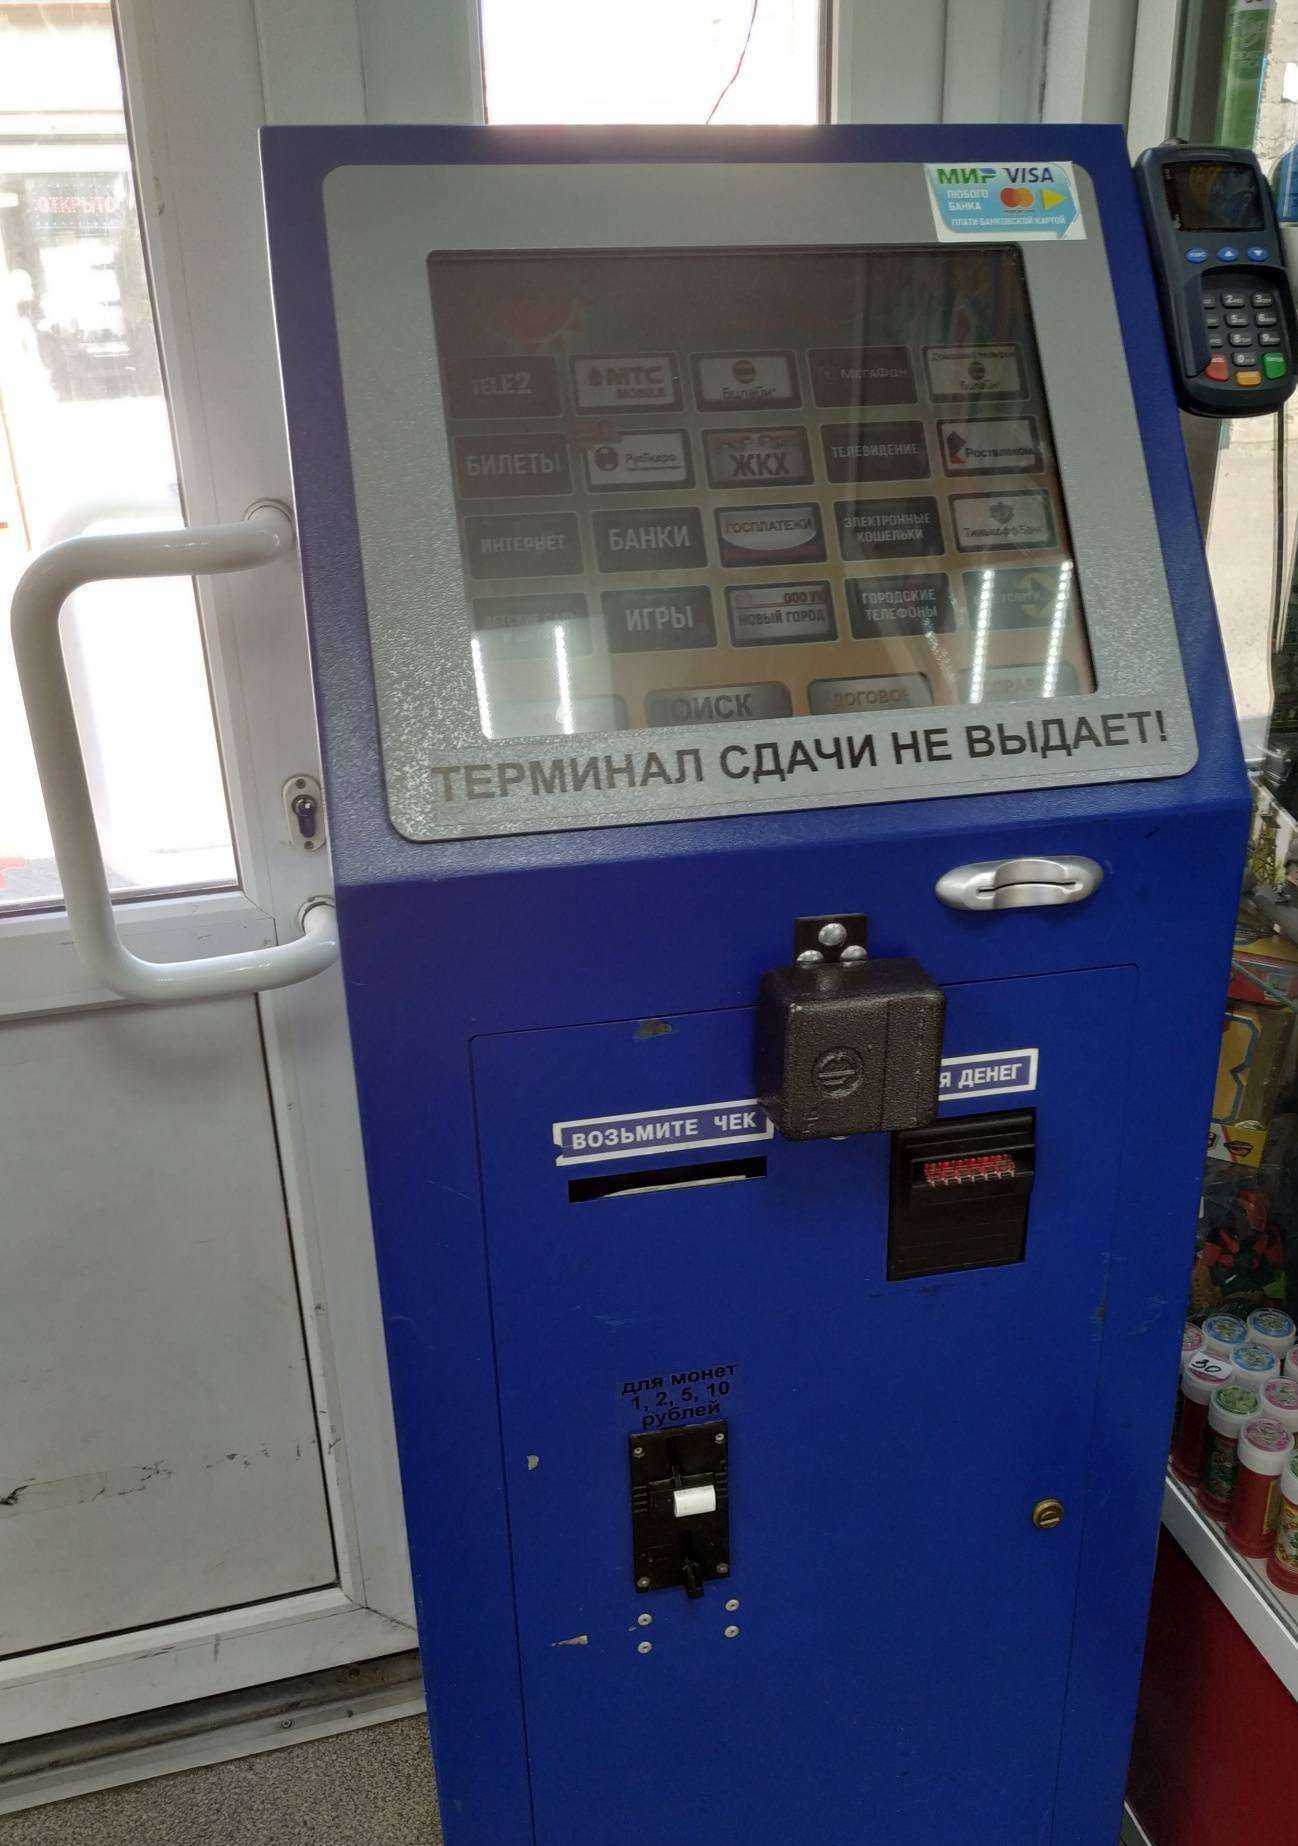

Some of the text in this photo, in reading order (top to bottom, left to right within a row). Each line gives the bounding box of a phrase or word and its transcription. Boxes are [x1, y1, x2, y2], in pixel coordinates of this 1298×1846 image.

[937, 168, 997, 184] МИР
[1001, 167, 1054, 183] VISA
[947, 189, 989, 199] ЛЮБОГО
[38, 195, 114, 214] ОТКРЫТО
[948, 202, 982, 211] БАНКА
[1034, 215, 1066, 225] КАРТОЙ
[607, 366, 664, 386] МТС
[831, 444, 920, 459] ТЕЛЕВИДЕНИЕ
[465, 453, 562, 476] БИЛЕТЫ
[730, 452, 790, 477] ЖКХ
[843, 513, 931, 528] ЭЛЕКТРОННЫЕ
[480, 535, 567, 553] ИНТЕРНЕТ
[608, 525, 690, 552] БАНКИ
[856, 529, 925, 544] КОШЕЛЬКИ
[862, 588, 937, 605] ГОРОДСКИЕ
[625, 605, 692, 632] ИГРЫ
[737, 609, 827, 627] НОВЫЙ ГОРОД
[865, 606, 938, 621] ТЕЛЕФОНЫ
[668, 692, 754, 721] ОИСК
[432, 709, 1168, 802] ТЕРМИНАЛ СДАЧИ НЕ ВЫДАЕТ!
[958, 1063, 1022, 1092] ДЕНЕГ
[571, 1110, 757, 1151] ВОЗЬМИТЕ ЧЕК
[1191, 1358, 1222, 1374] 30
[622, 1364, 737, 1396] для монет
[631, 1380, 730, 1412] 1, 2, 5, 10
[642, 1400, 720, 1430] рублей
